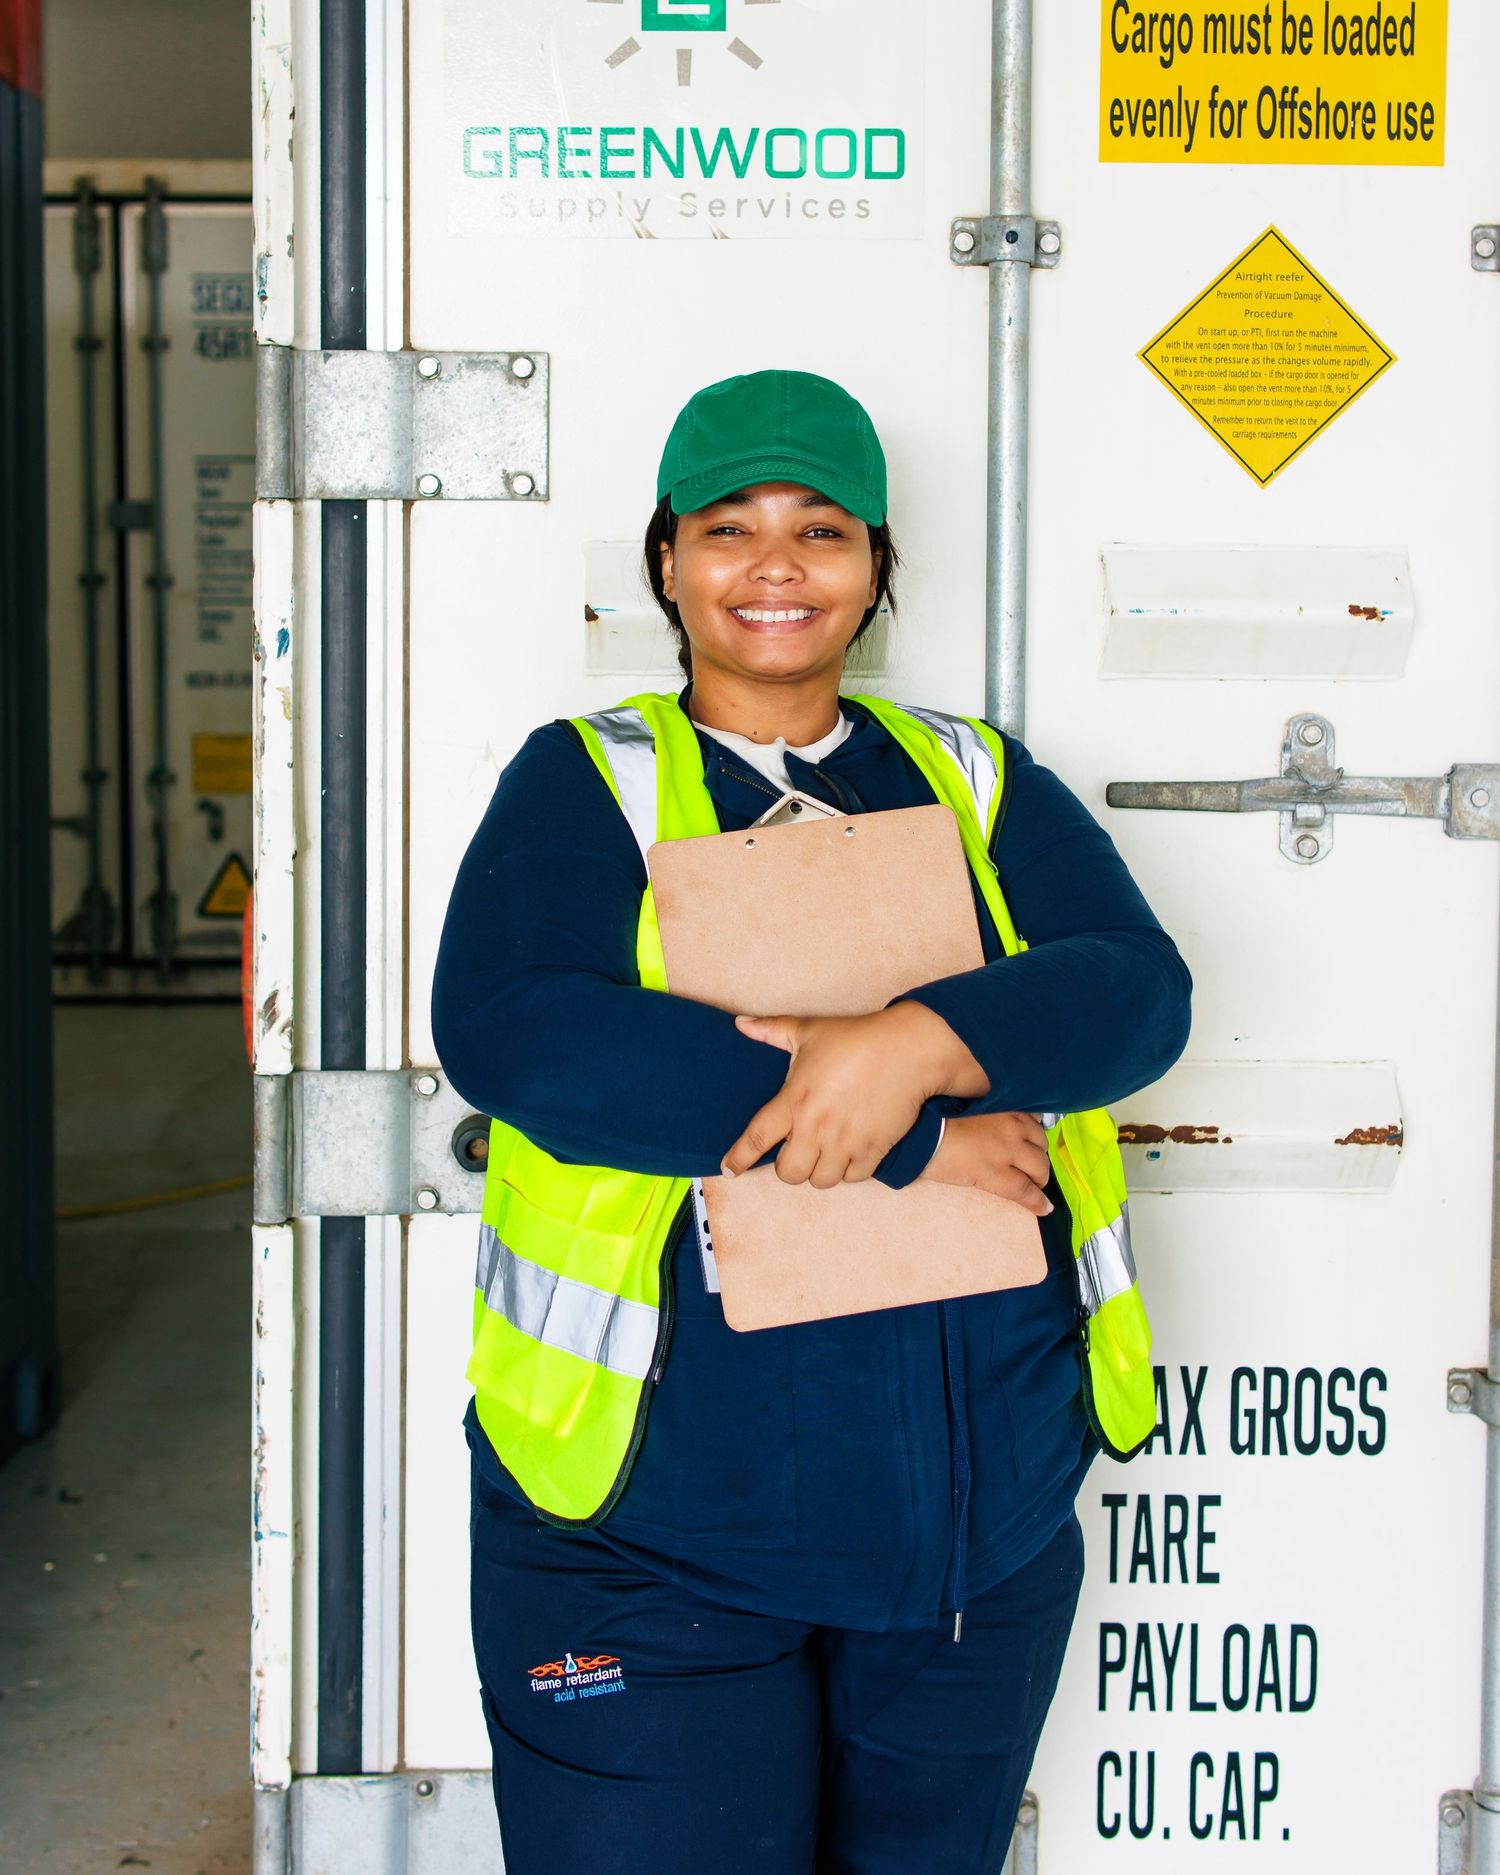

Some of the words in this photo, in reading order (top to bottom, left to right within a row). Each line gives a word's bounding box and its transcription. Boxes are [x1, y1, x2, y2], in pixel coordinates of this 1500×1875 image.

[1111, 0, 1194, 68] Cargo
[1203, 2, 1272, 55] must
[1282, 0, 1312, 55] be
[1324, 0, 1415, 56] loaded
[1110, 85, 1199, 153] evenly
[1208, 85, 1247, 138] for
[1257, 86, 1376, 140] Offshore
[1386, 100, 1434, 140] use
[463, 126, 906, 180] GREENWOOD
[500, 192, 651, 222] Supply
[679, 192, 870, 218] Services
[1236, 272, 1272, 282] Airtight
[1276, 273, 1304, 281] reefer
[1217, 290, 1252, 300] Prevention
[1255, 291, 1262, 299] of
[1264, 291, 1292, 300] Vacuum
[1294, 292, 1322, 302] Damage
[1244, 309, 1293, 318] Procedure
[1198, 327, 1208, 336] On
[1211, 328, 1226, 336] start
[1228, 329, 1239, 337] up,
[1266, 328, 1280, 336] first
[1309, 330, 1338, 338] machine
[1252, 342, 1268, 350] than
[1271, 342, 1283, 350] 10%
[1286, 342, 1295, 351] for
[1298, 343, 1302, 351] 5
[1305, 344, 1332, 352] minutes
[1335, 344, 1369, 353] minimum,
[1200, 355, 1212, 363] the
[1215, 356, 1249, 365] pressure
[1263, 356, 1275, 364] the
[1278, 357, 1310, 367] changes
[1313, 357, 1341, 365] volume
[1344, 358, 1372, 367] rapidly.
[1194, 370, 1227, 378] pre-cooled
[1229, 370, 1248, 378] loaded
[1251, 370, 1261, 378] box
[1286, 372, 1303, 380] cargo
[1327, 371, 1349, 380] opened
[1351, 372, 1359, 380] for
[1181, 384, 1192, 392] any
[1224, 383, 1236, 392] also
[1239, 385, 1254, 393] open
[1256, 384, 1266, 392] the
[1303, 385, 1317, 393] than
[1336, 385, 1344, 393] for
[1348, 385, 1351, 393] 5
[1248, 398, 1261, 407] prior
[1271, 398, 1292, 408] closing
[1294, 398, 1304, 407] the
[1306, 400, 1322, 408] cargo
[1213, 416, 1245, 424] Remember
[1274, 416, 1284, 424] the
[1232, 431, 1256, 440] carriage
[1258, 431, 1297, 440] requirements
[1143, 1366, 1208, 1456] AX
[1229, 1366, 1388, 1456] GROSS
[1101, 1494, 1222, 1584] TARE
[1098, 1622, 1318, 1712] PAYLOAD
[530, 1678, 562, 1692] flame
[566, 1666, 622, 1686] retardant
[554, 1688, 575, 1702] acid
[579, 1679, 626, 1699] resistant
[1096, 1750, 1170, 1840] CU.
[1189, 1751, 1290, 1840] CAP.
